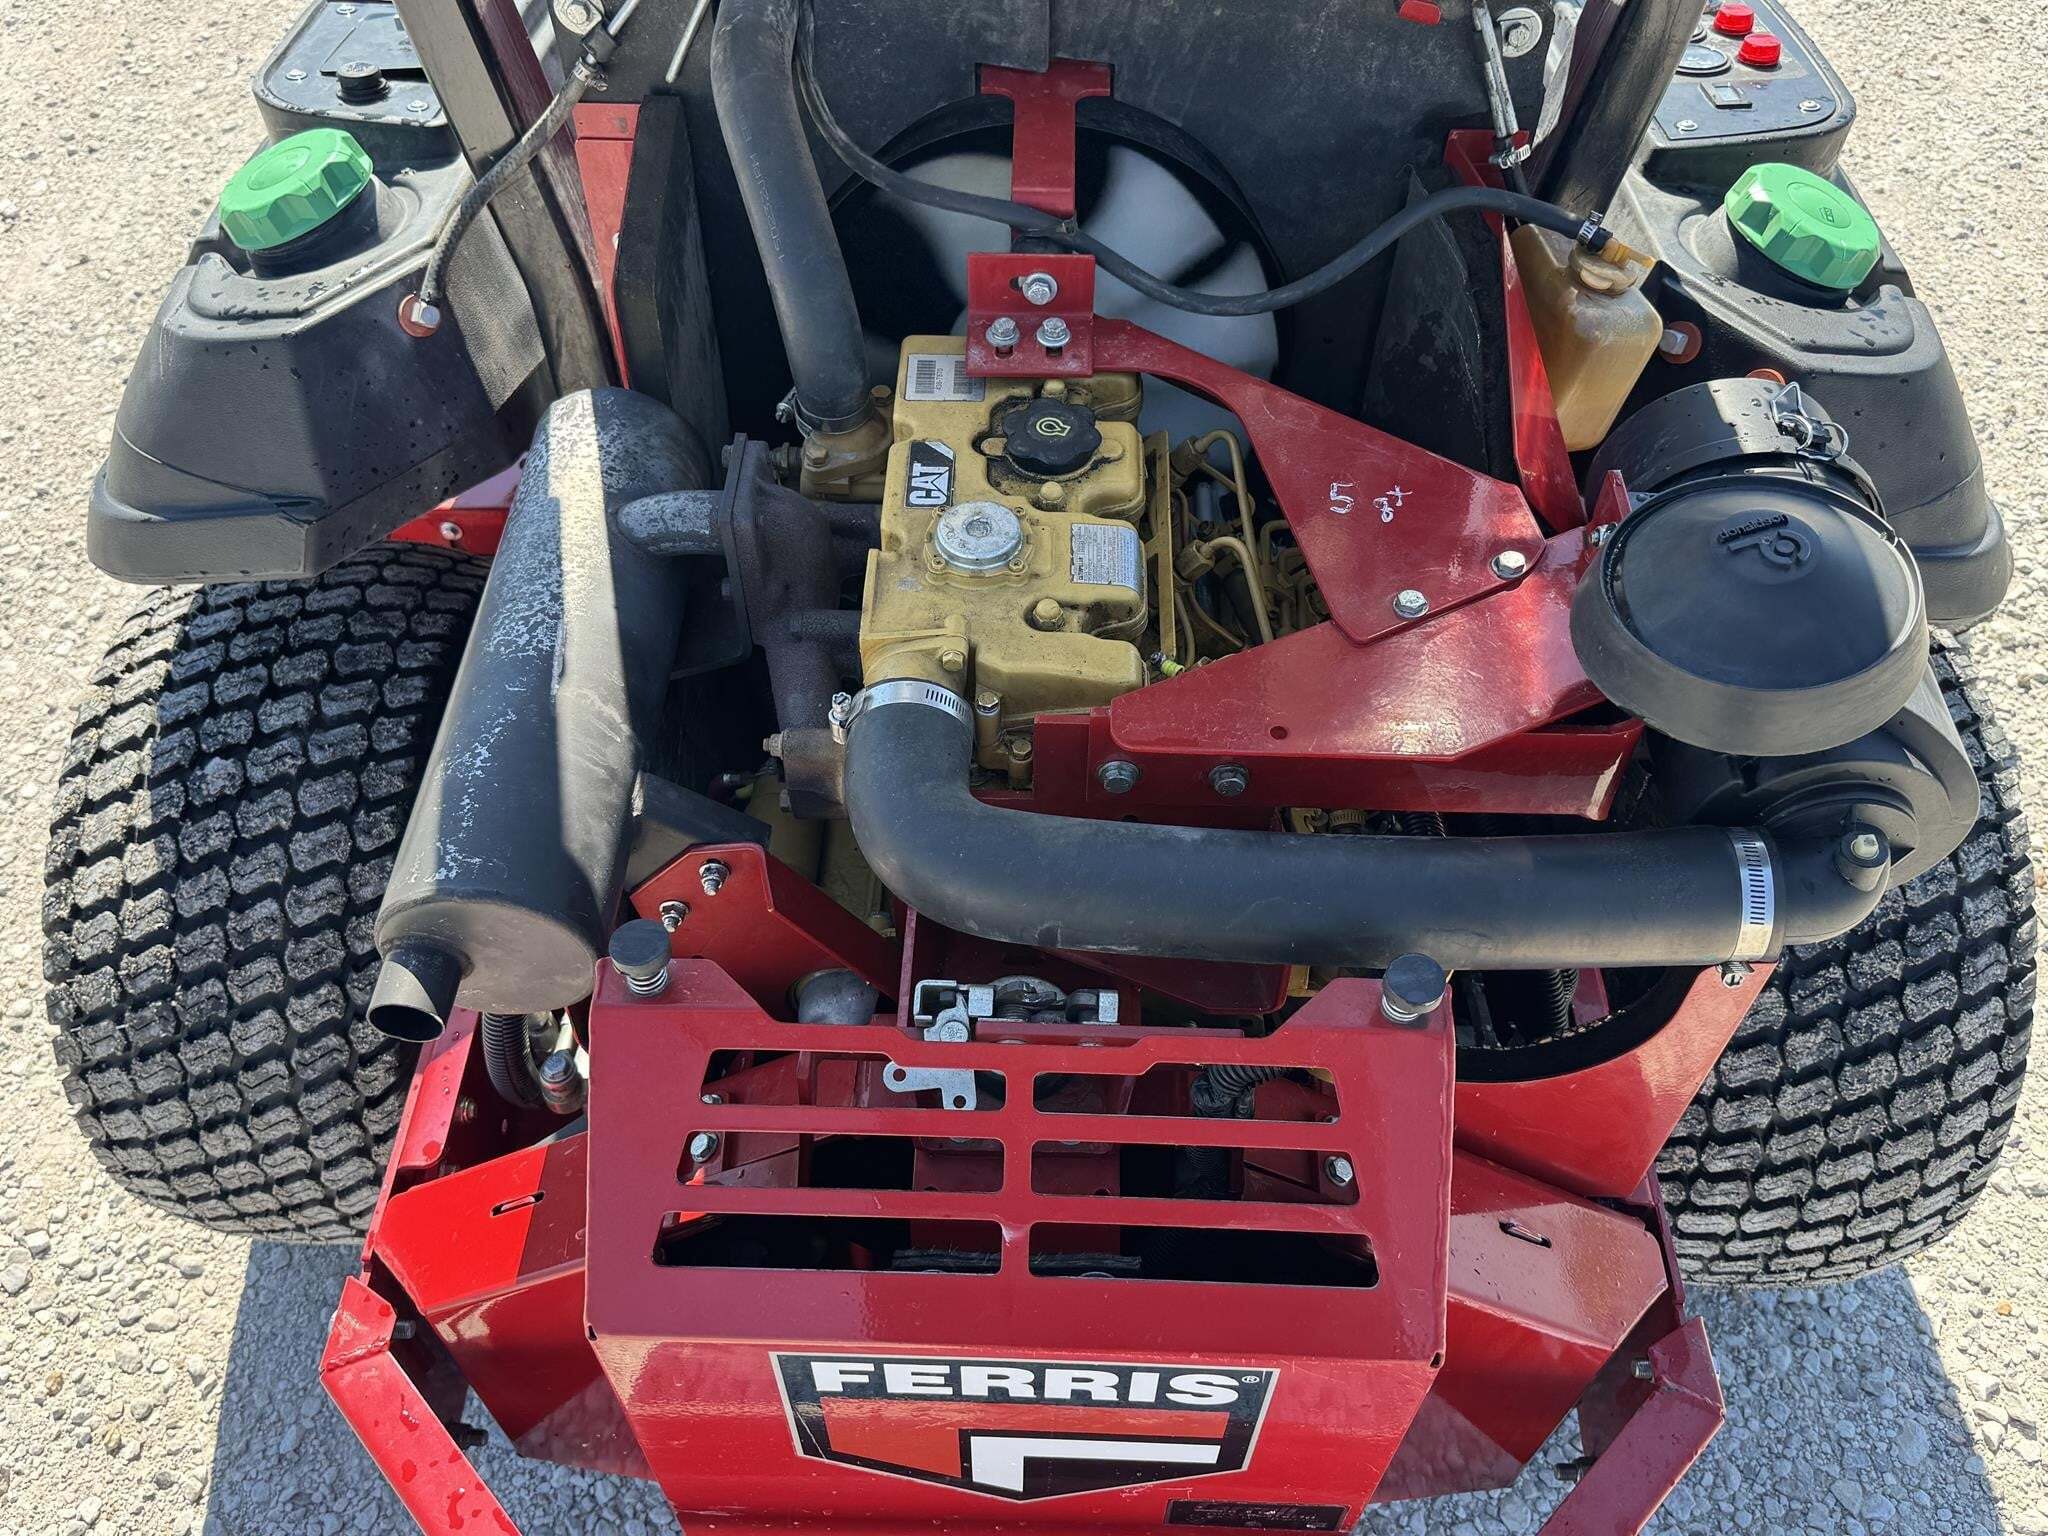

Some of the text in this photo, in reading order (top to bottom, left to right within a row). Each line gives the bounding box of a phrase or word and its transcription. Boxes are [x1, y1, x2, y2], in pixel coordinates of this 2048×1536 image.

[910, 462, 950, 505] CAT
[1329, 481, 1355, 515] 5
[1718, 513, 1789, 542] donaldson
[810, 1361, 1239, 1405] FERRIS
